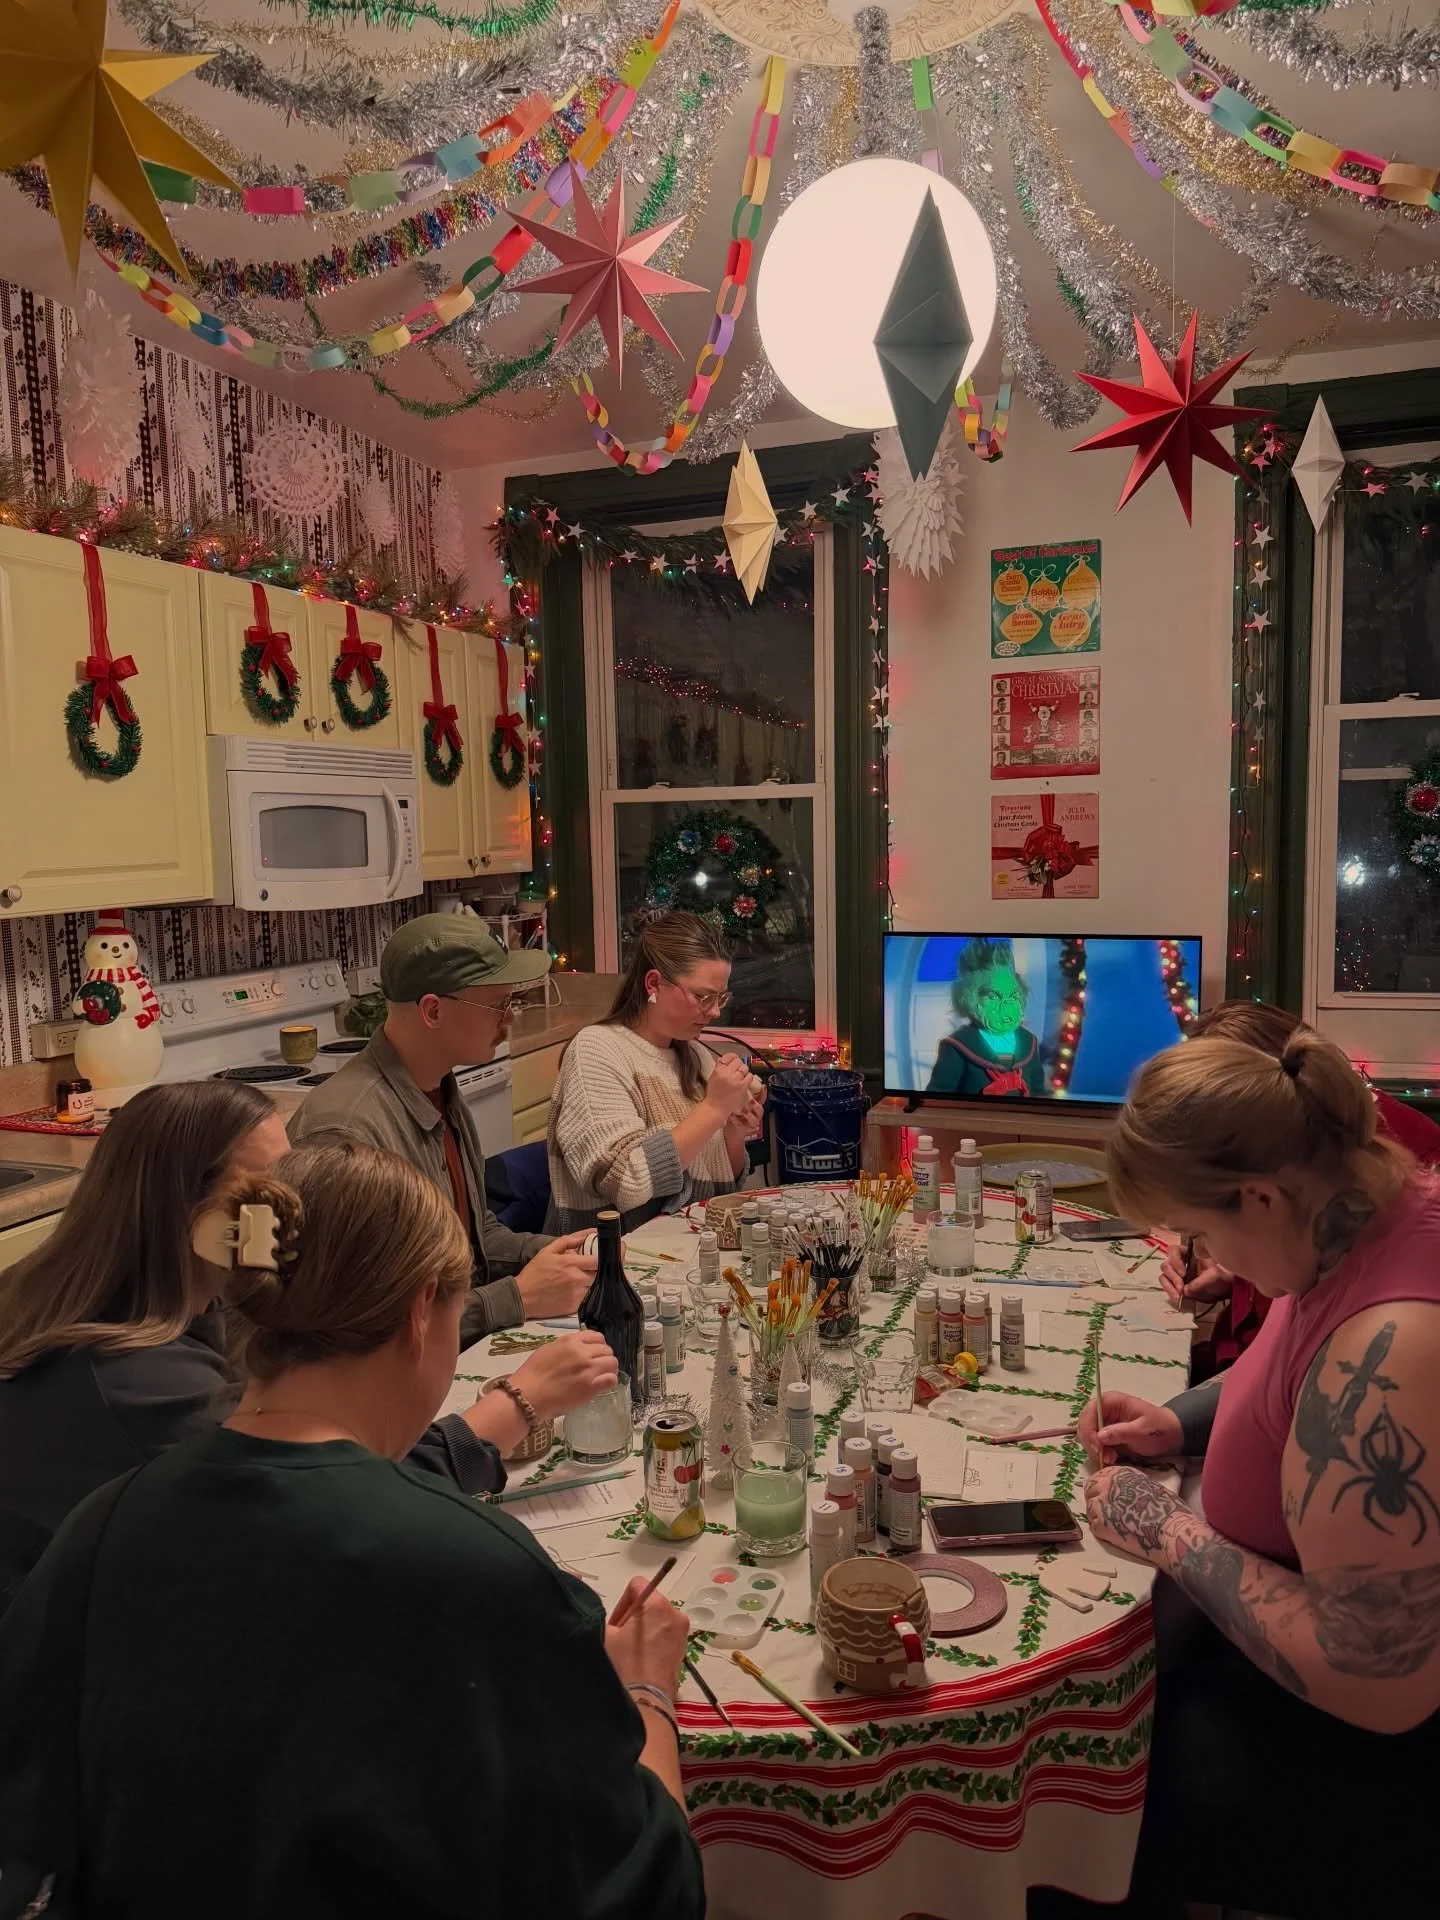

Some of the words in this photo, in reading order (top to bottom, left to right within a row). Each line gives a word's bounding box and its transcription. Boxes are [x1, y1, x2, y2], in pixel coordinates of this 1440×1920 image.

[1011, 676, 1037, 685] GREAT
[1038, 674, 1065, 682] SONGS
[1011, 681, 1079, 697] CHRISTMAS
[1060, 813, 1096, 821] ANDREWS
[791, 1150, 854, 1170] LOWES
